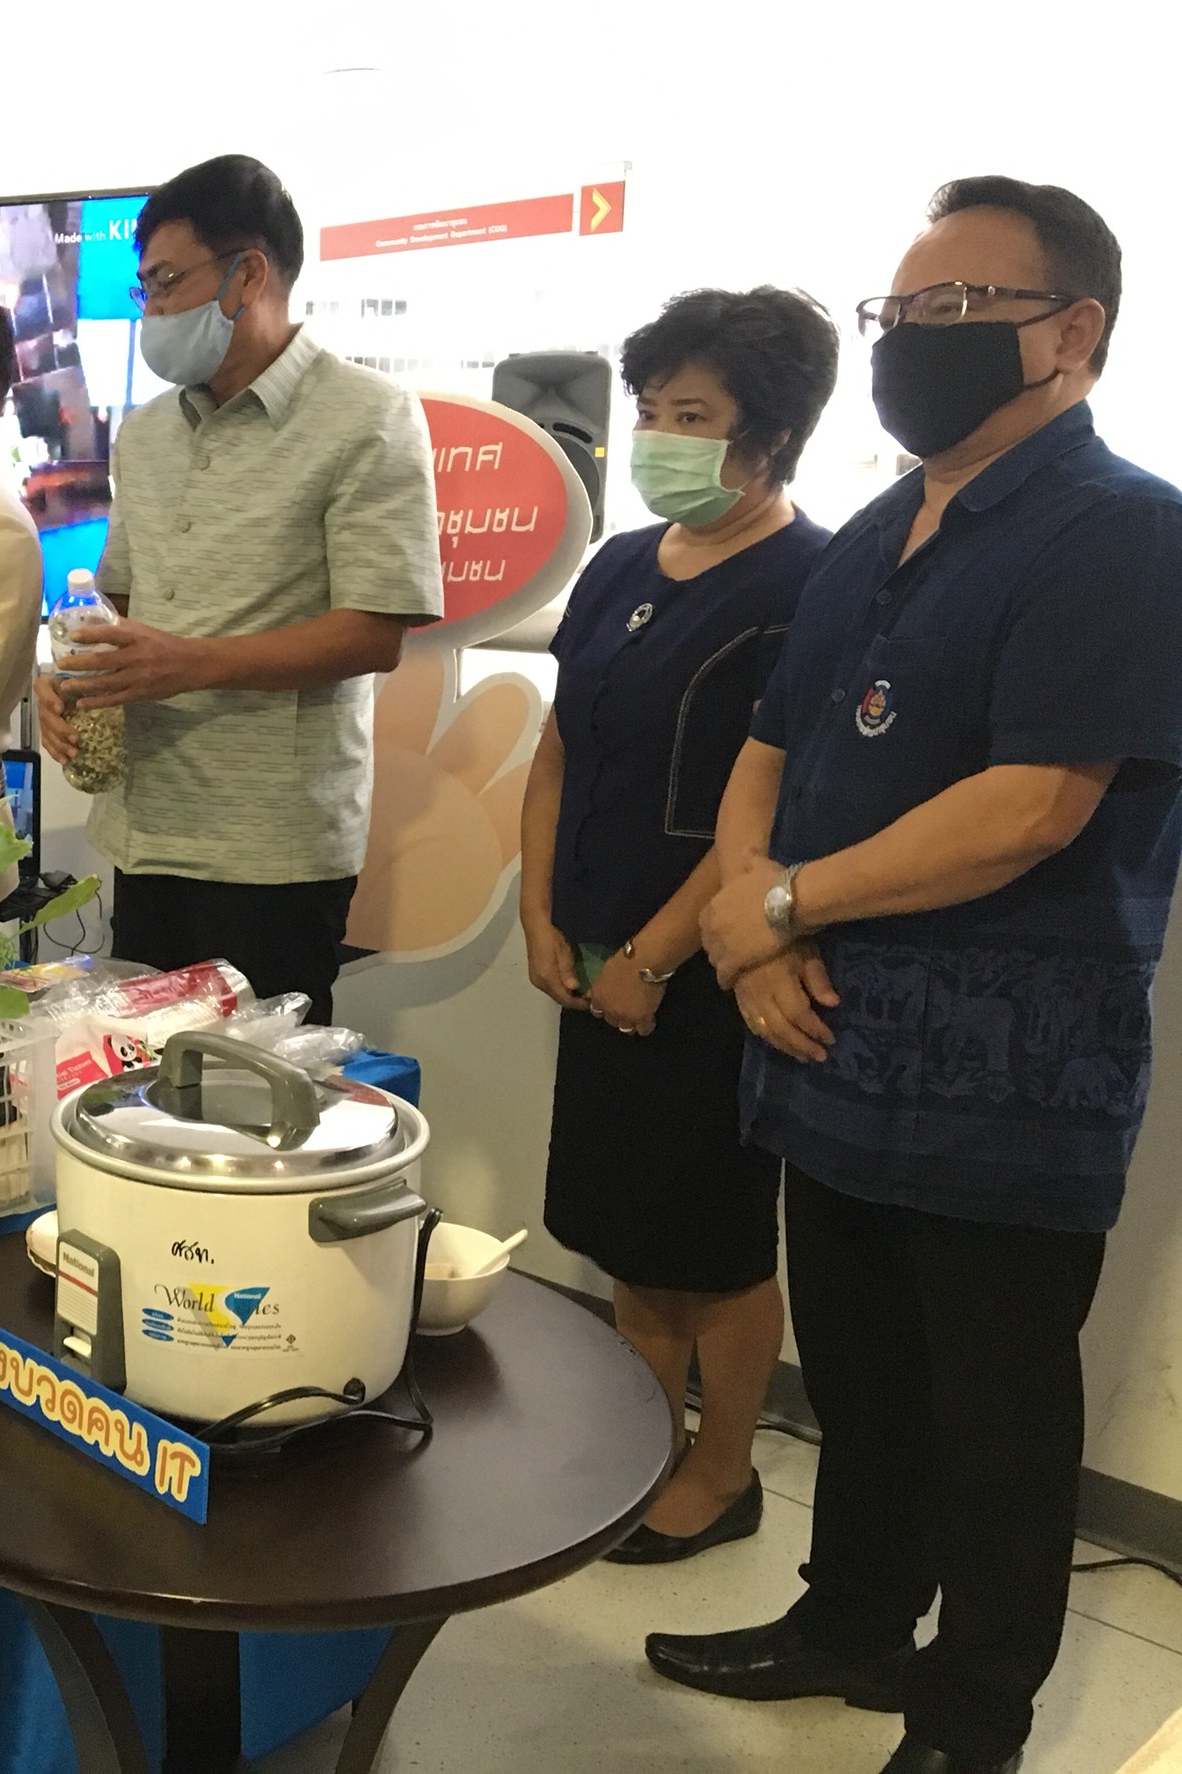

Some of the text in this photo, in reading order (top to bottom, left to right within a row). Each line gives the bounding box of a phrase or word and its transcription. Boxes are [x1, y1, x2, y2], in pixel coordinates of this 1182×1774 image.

[55, 233, 82, 244] Made
[85, 231, 107, 242] with
[63, 1252, 95, 1277] National
[154, 1283, 215, 1313] World
[159, 1445, 196, 1496] IT
